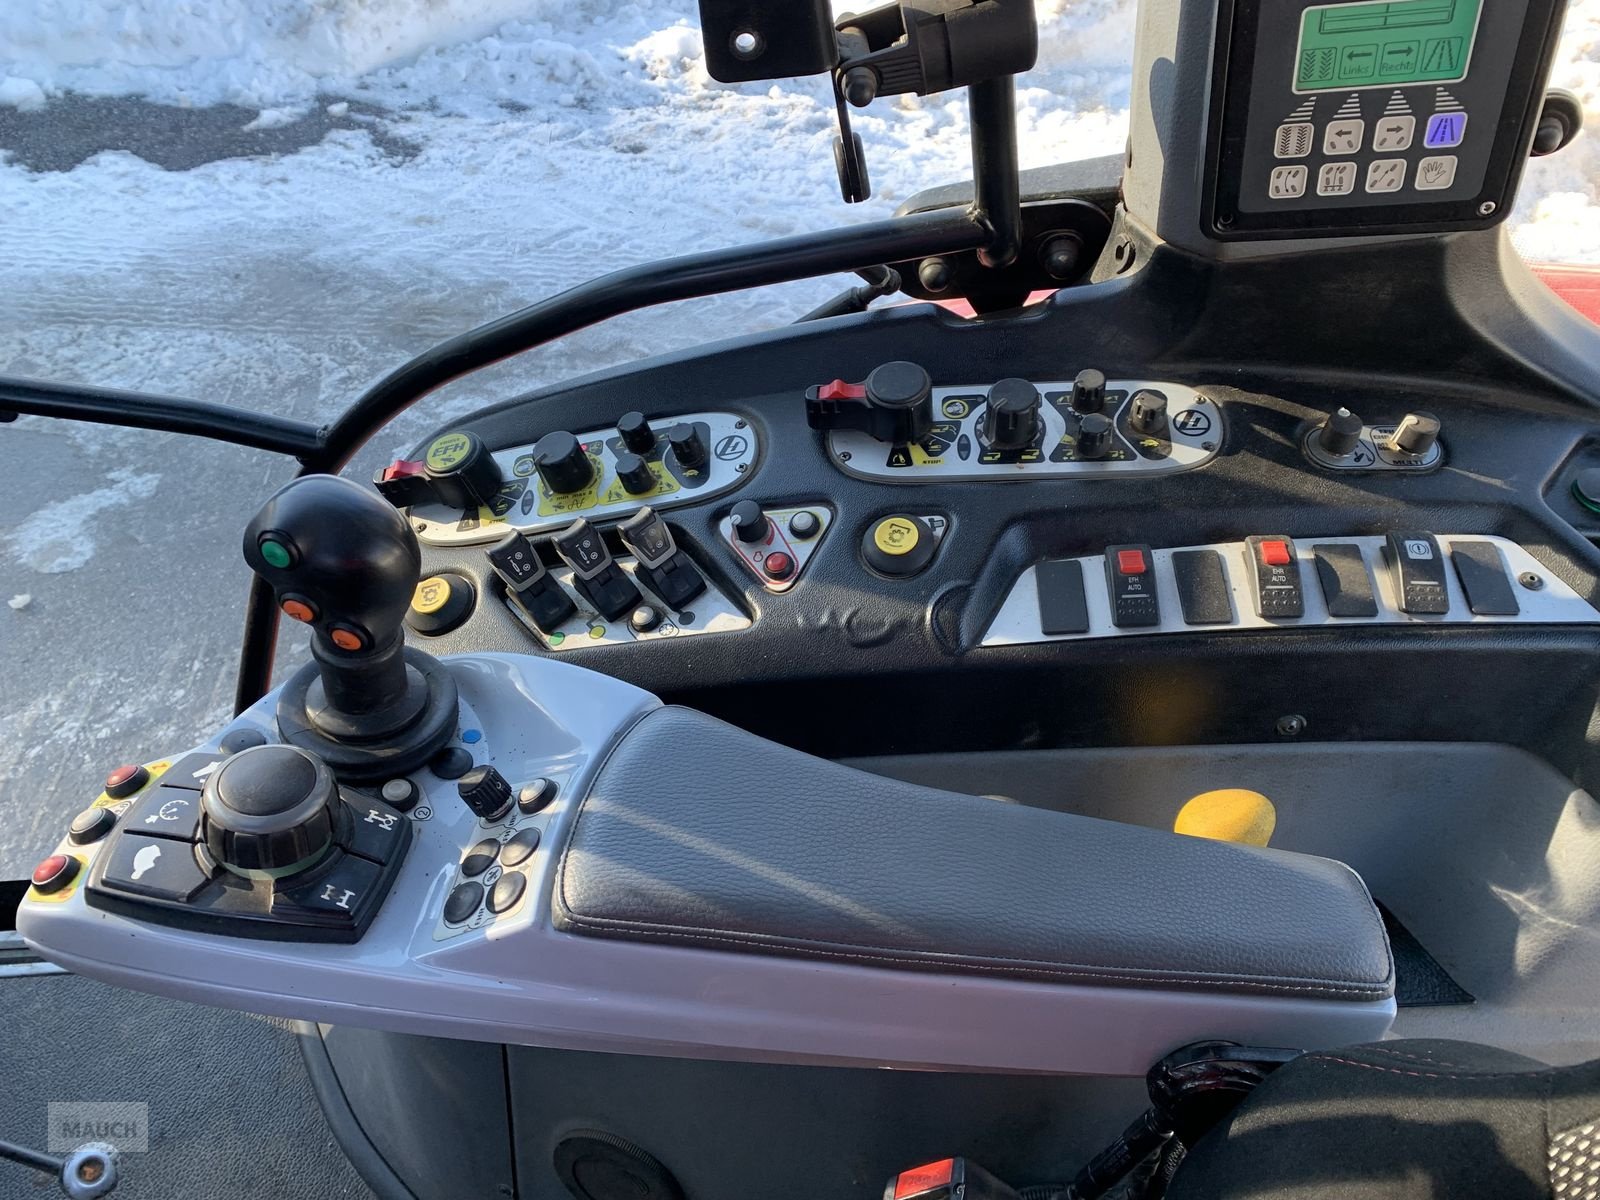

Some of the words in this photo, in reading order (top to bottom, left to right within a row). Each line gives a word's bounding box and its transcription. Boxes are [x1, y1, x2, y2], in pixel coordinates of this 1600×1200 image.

[1343, 64, 1370, 76] Links
[1381, 60, 1415, 72] Rechts
[431, 441, 466, 457] EFH
[1128, 576, 1140, 584] EFH
[1271, 575, 1287, 583] AUTO
[1128, 583, 1143, 592] AUTO
